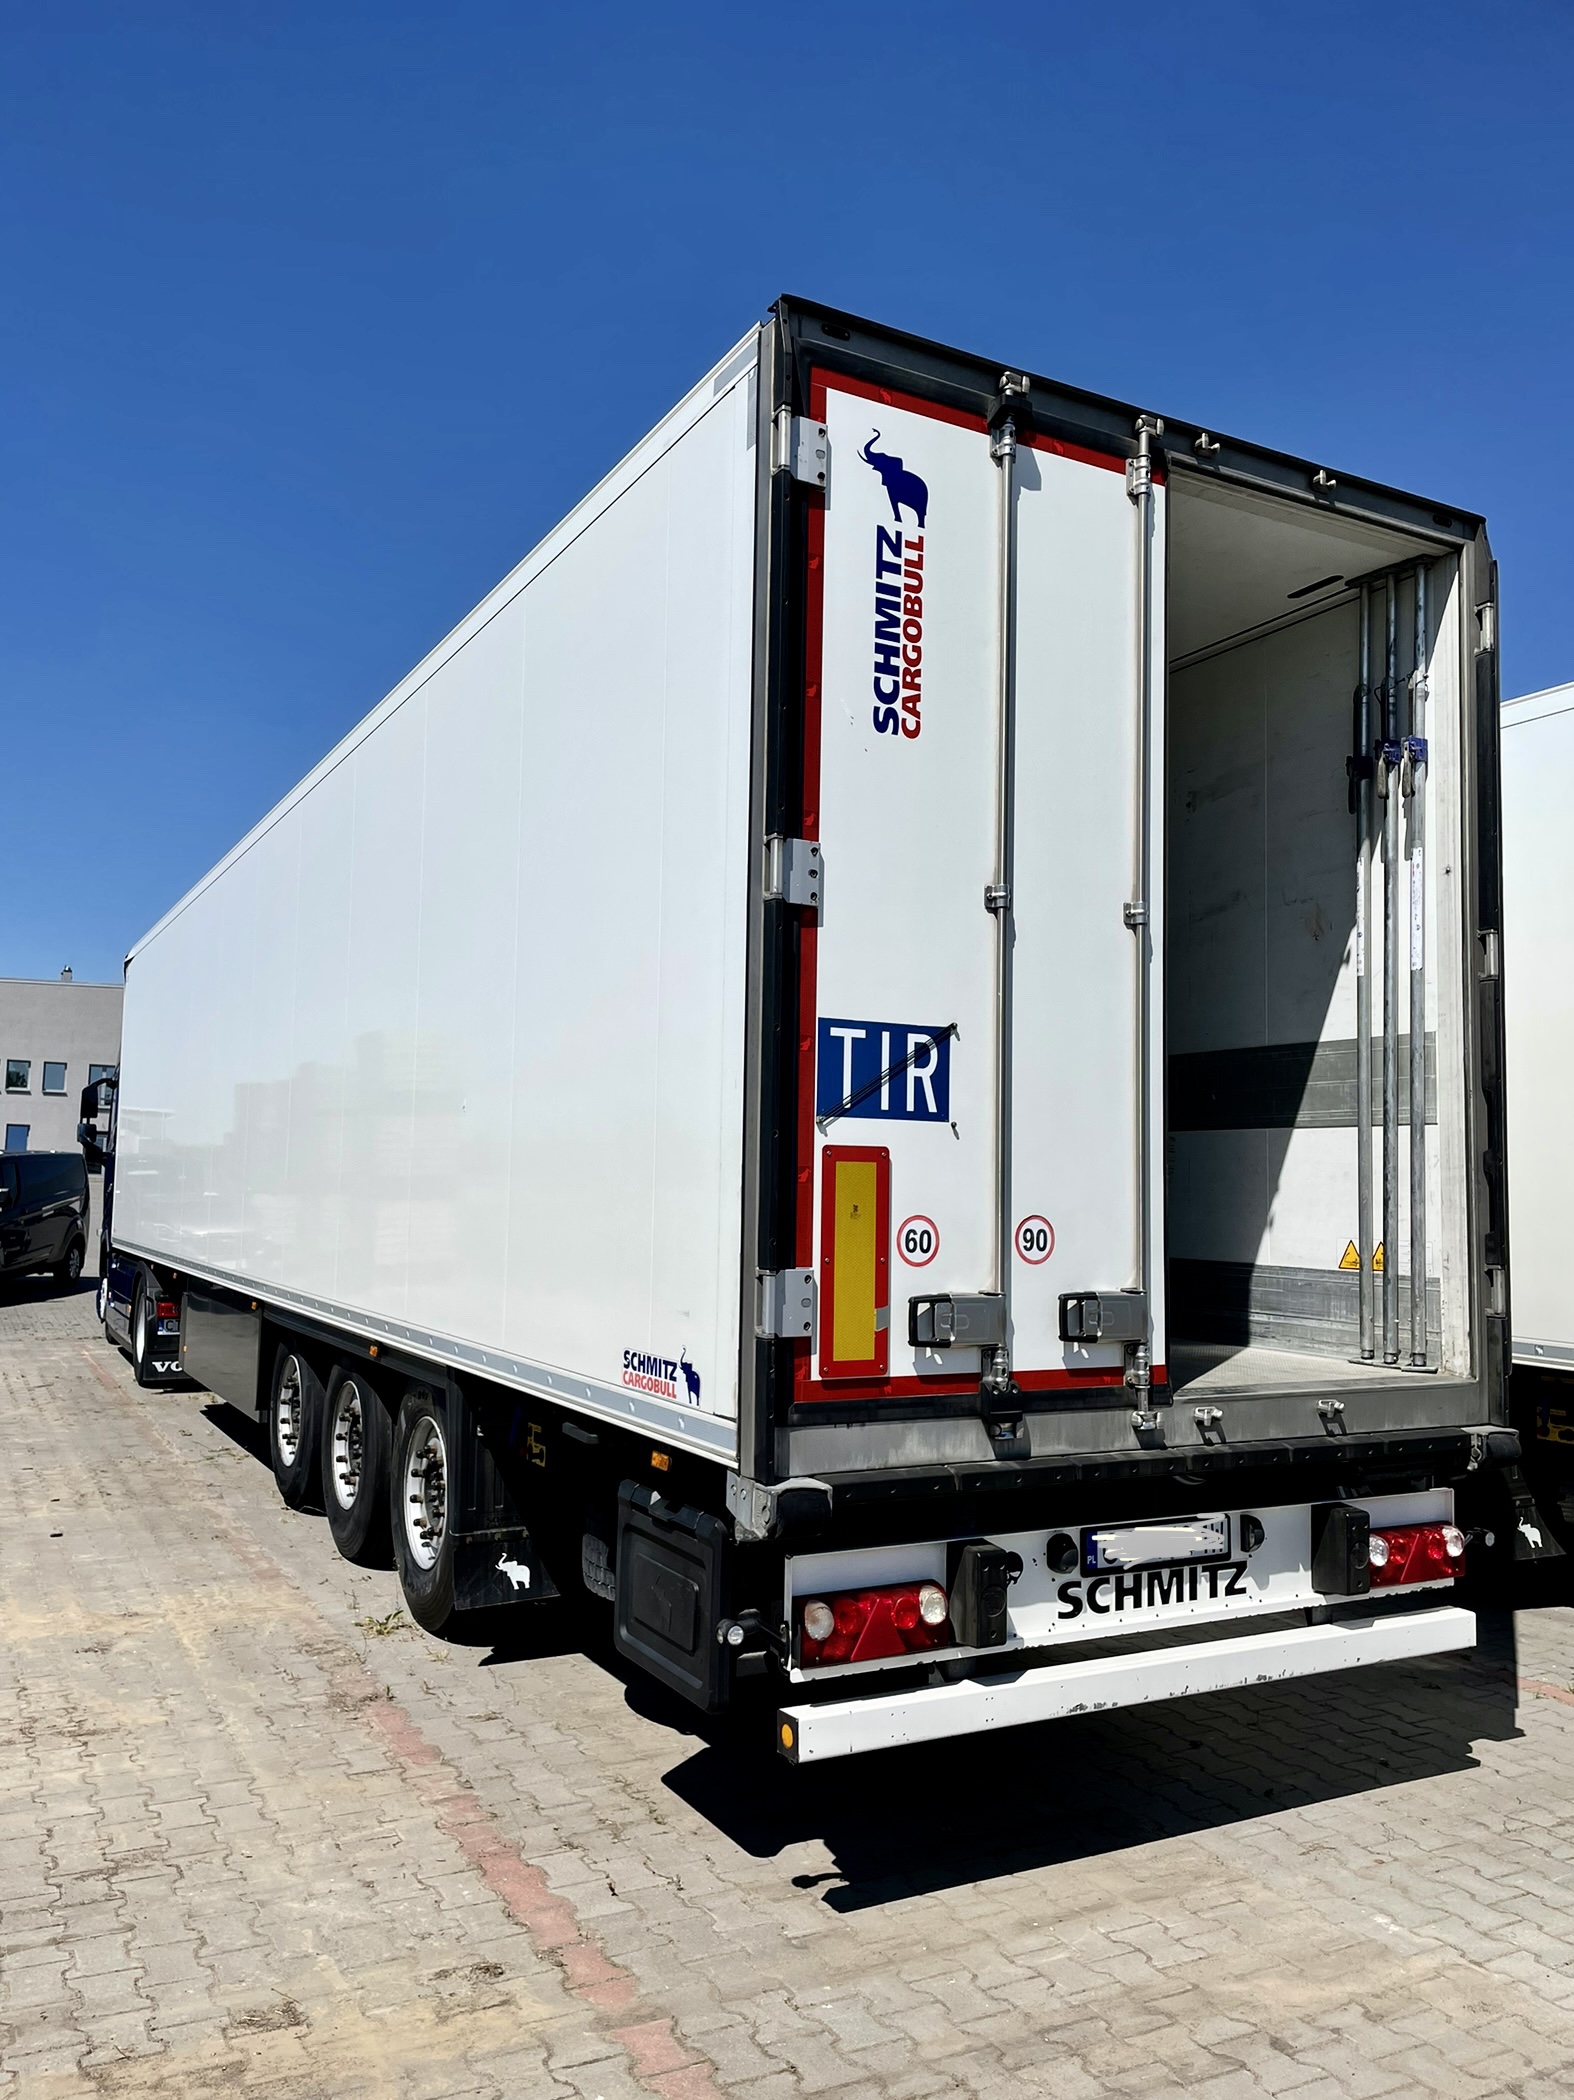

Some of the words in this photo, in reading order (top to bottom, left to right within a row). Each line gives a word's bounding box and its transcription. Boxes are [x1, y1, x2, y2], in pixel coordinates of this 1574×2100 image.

[873, 524, 902, 736] SCHMITZ
[901, 535, 924, 739] CARGOBULL
[830, 1026, 938, 1113] TIR
[905, 1228, 932, 1254] 60
[1022, 1227, 1048, 1252] 90
[623, 1349, 678, 1382] SCHMITZ
[622, 1370, 677, 1399] CARGOBULL
[1087, 1555, 1097, 1565] PL
[1057, 1560, 1248, 1620] SCHMITZ
